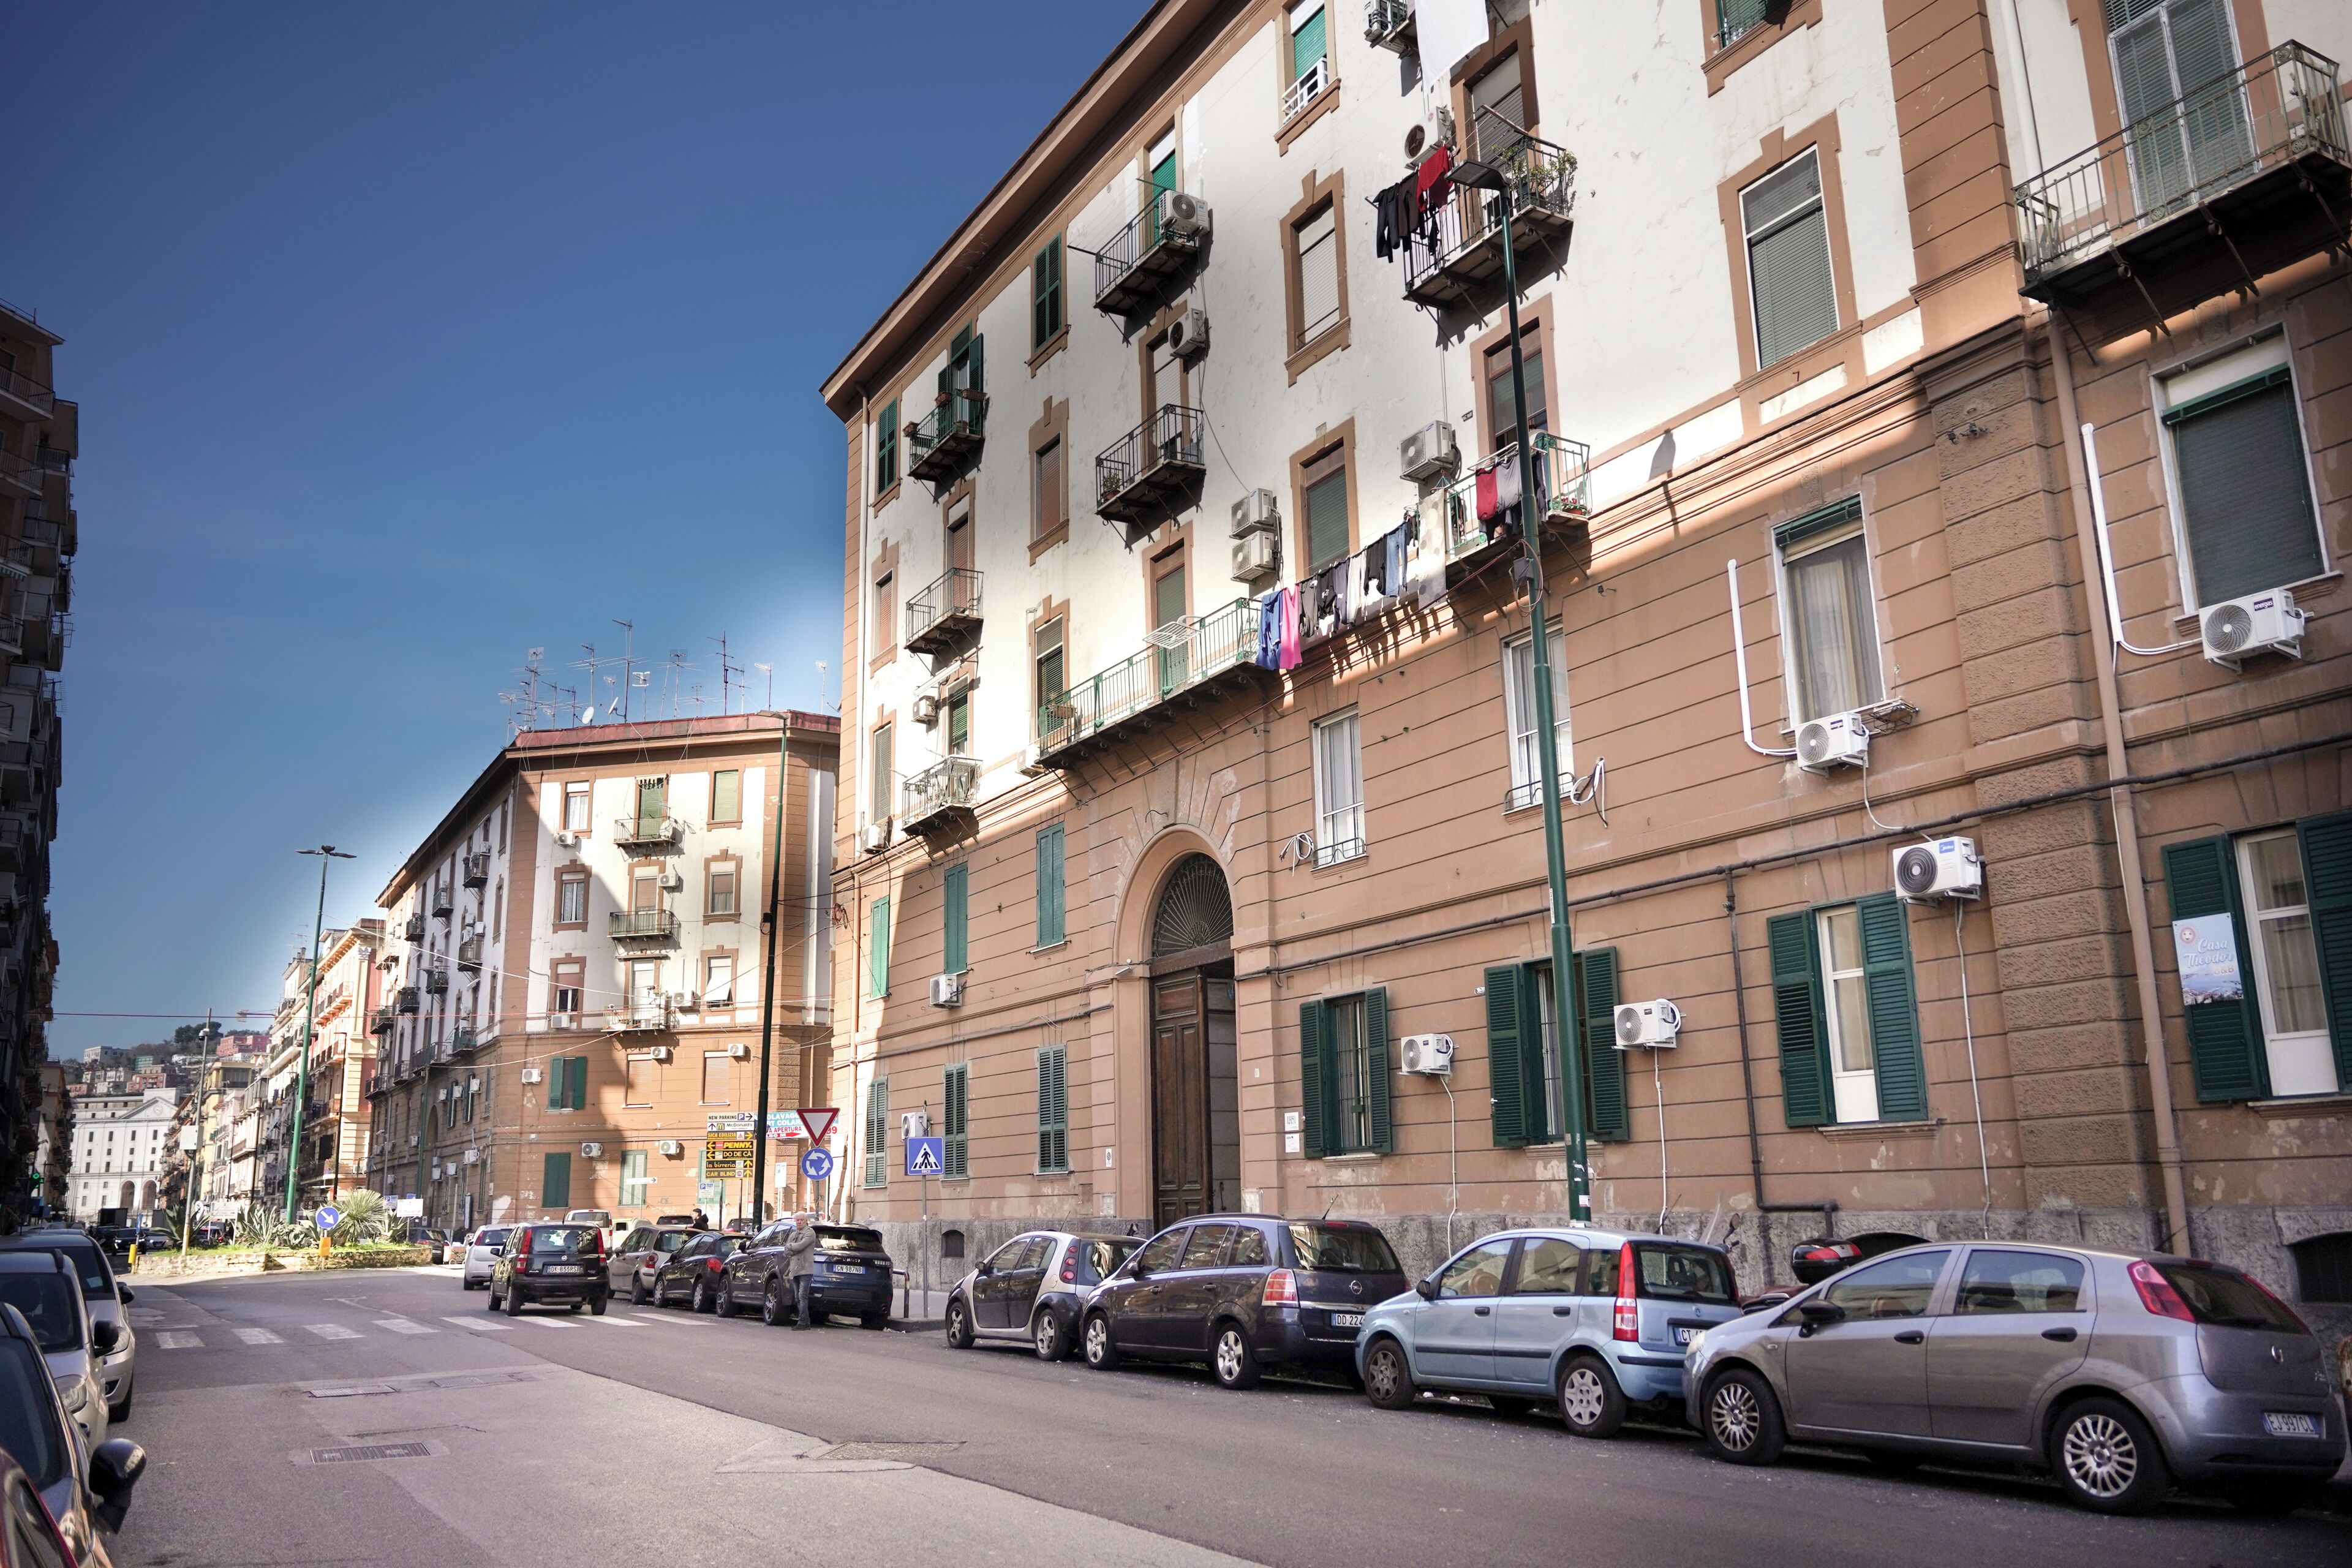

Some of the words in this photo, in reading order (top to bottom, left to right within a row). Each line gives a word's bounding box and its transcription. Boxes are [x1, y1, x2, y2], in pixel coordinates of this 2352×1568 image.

[2254, 600, 2273, 609] energas
[2198, 938, 2228, 954] Casa
[1337, 1314, 1347, 1325] DD
[1681, 1329, 1692, 1342] CT
[2267, 1414, 2283, 1431] EJ
[2281, 1414, 2315, 1432] 997CL
